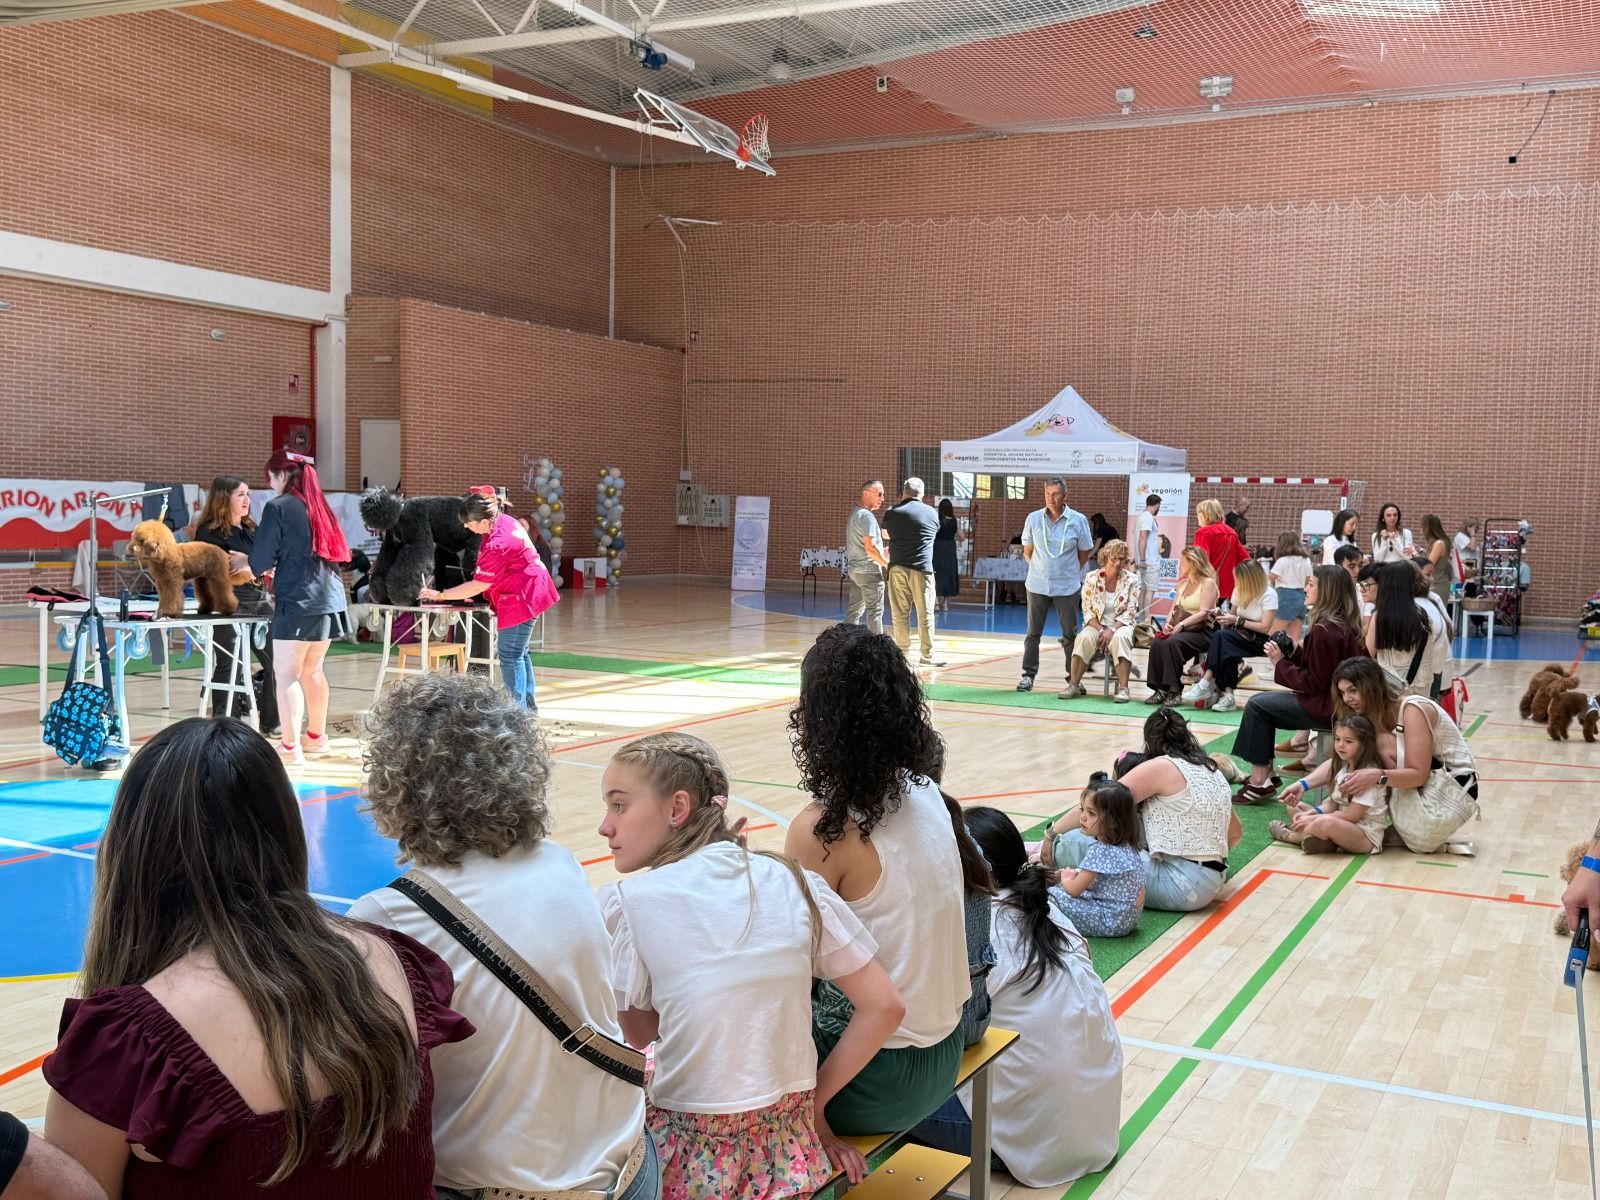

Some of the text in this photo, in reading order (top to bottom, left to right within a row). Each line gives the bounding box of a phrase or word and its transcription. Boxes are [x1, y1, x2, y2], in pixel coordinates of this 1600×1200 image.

[0, 489, 56, 517] RION
[61, 492, 126, 519] ARON
[451, 911, 567, 1025] PACOMARTINEZ
